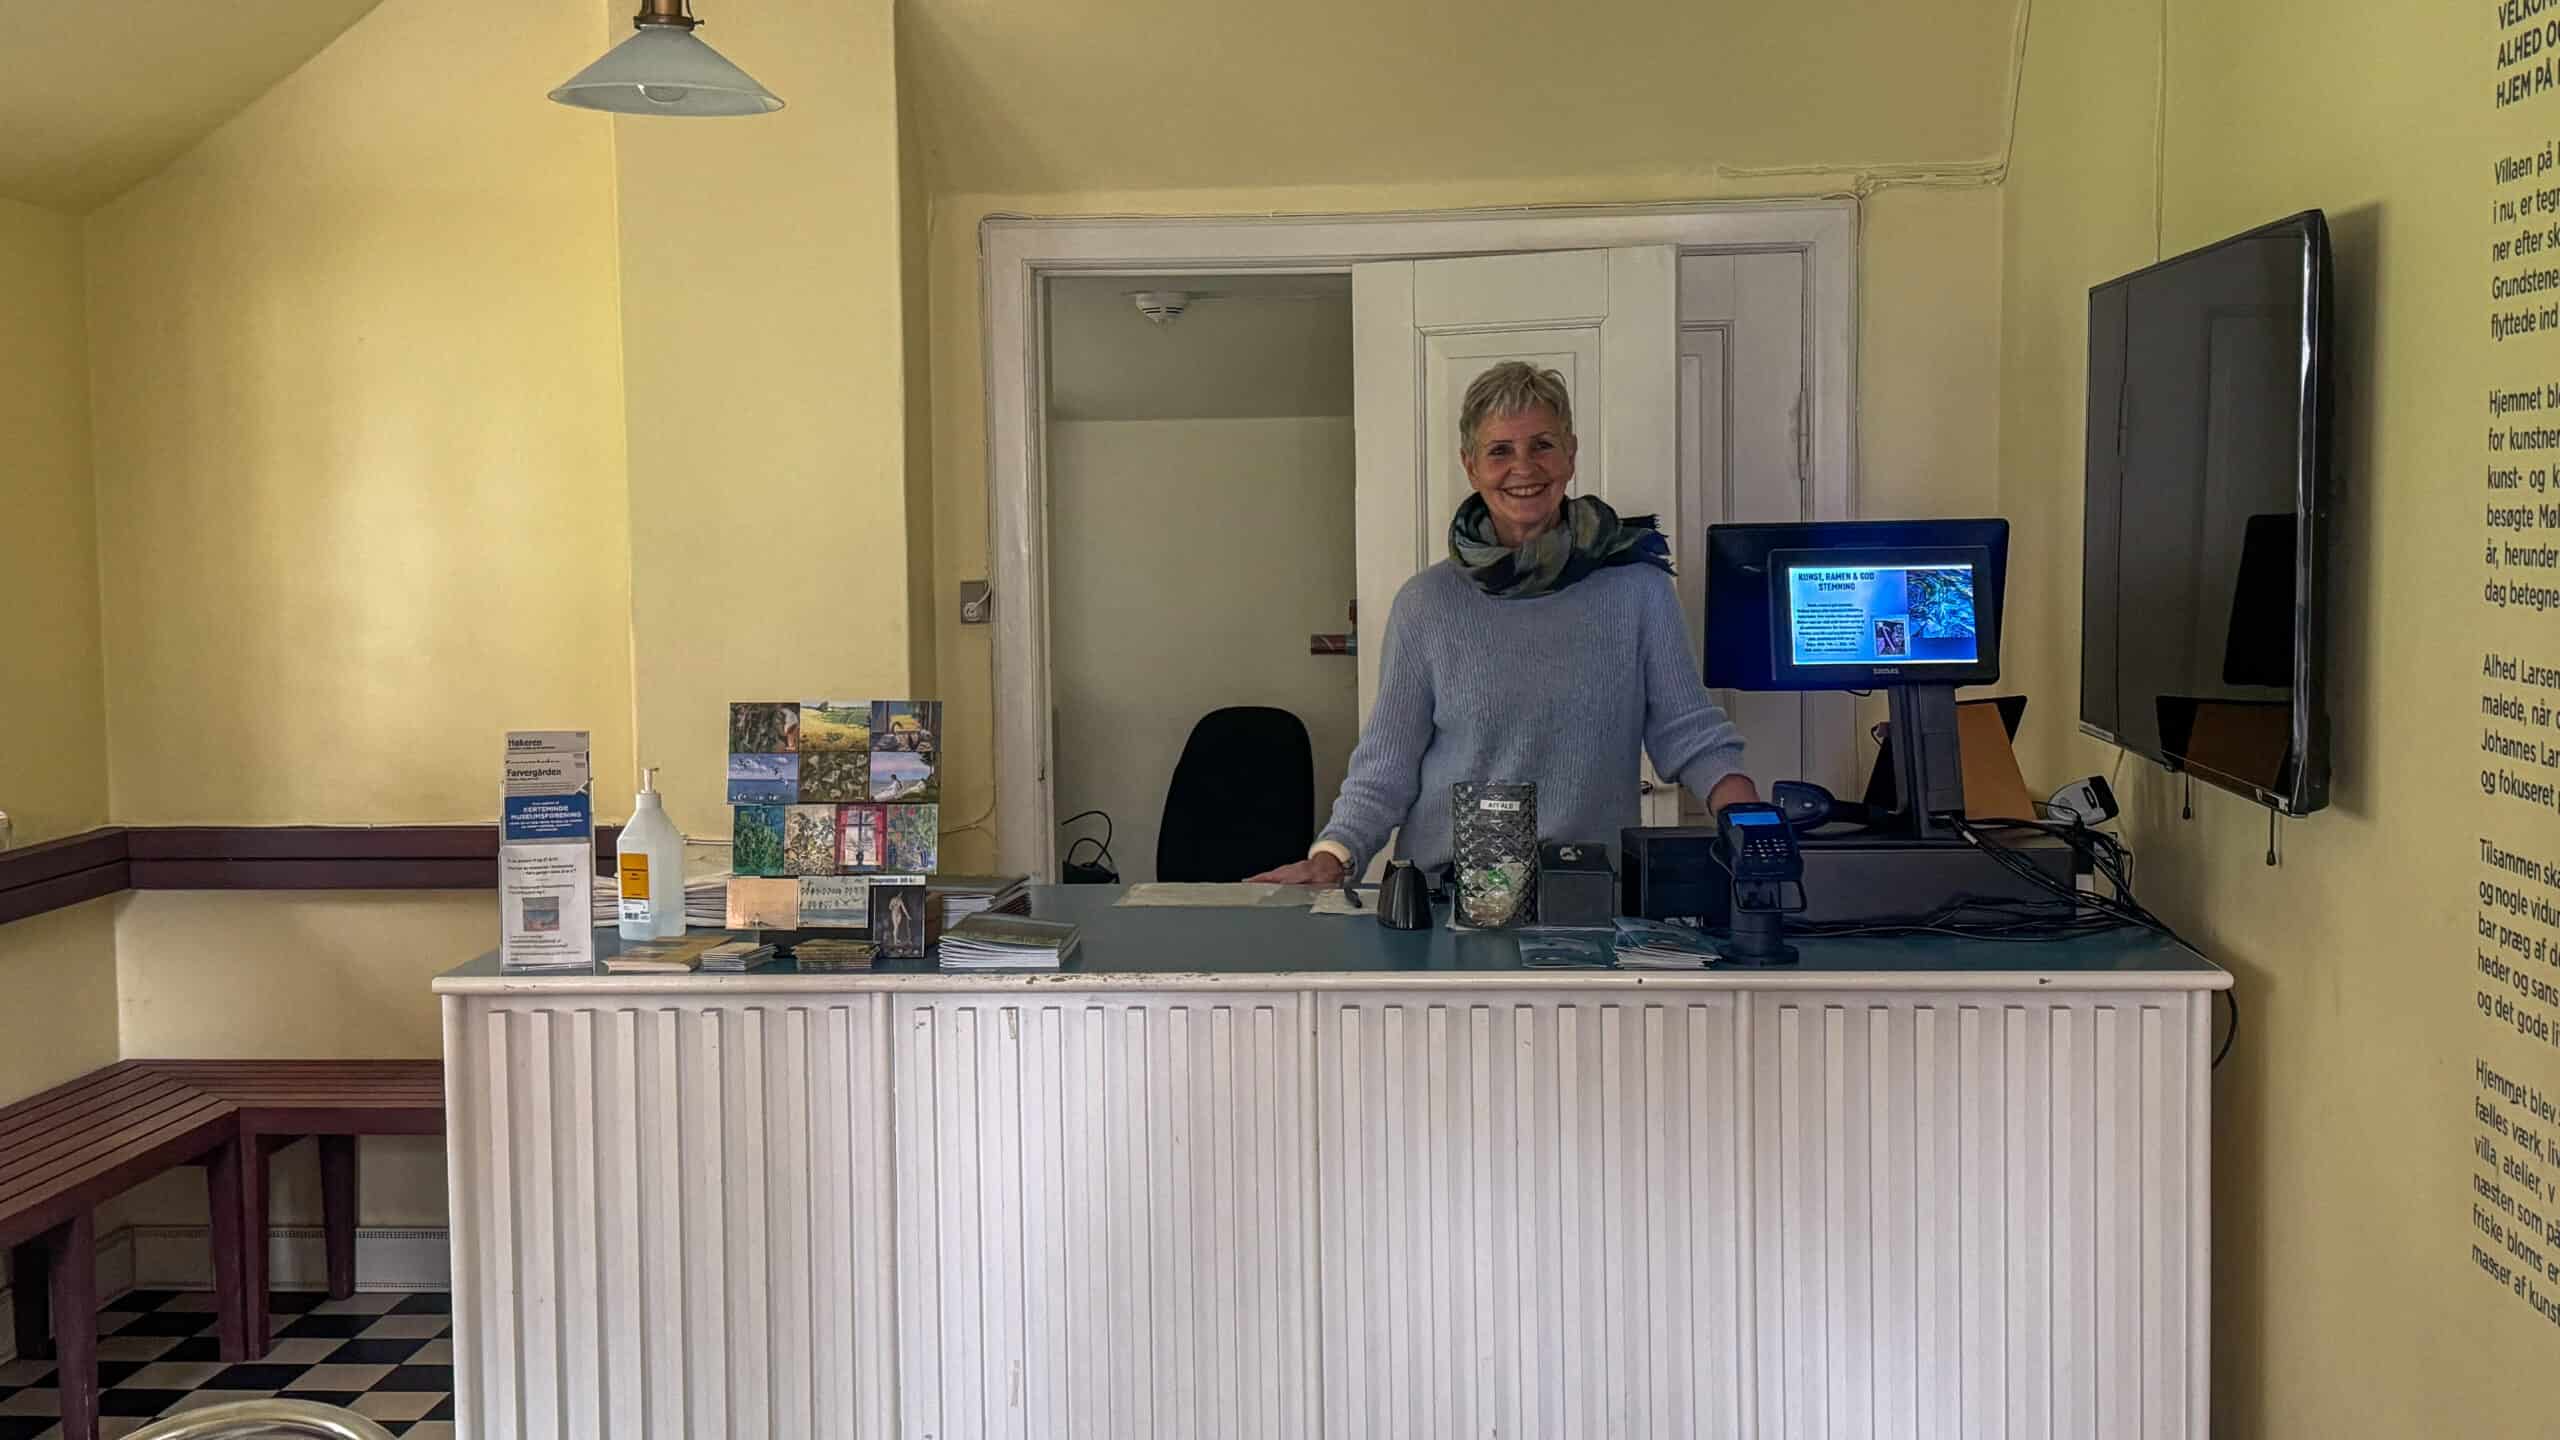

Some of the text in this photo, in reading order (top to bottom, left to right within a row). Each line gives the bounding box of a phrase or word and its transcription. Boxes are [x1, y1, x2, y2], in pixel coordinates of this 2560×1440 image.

[2497, 20, 2560, 70] ALHED O
[2496, 70, 2531, 109] HJEM
[2535, 57, 2553, 94] PÅ
[2494, 156, 2532, 185] Villaen
[2537, 140, 2553, 177] på
[2500, 201, 2517, 223] nu,
[2520, 193, 2533, 216] er
[2492, 239, 2512, 263] ner
[2515, 229, 2544, 257] efter
[2491, 302, 2559, 342] flyttede ind
[2489, 384, 2542, 418] Hjemmet
[2488, 427, 2504, 451] for
[2488, 464, 2523, 490] kunst-
[2529, 469, 2545, 493] og
[2487, 504, 2534, 532] besøgte
[2485, 538, 2559, 569] år, herunder
[2485, 576, 2506, 608] dag
[2482, 653, 2517, 681] Alhed
[2481, 692, 2528, 727] malede,
[2531, 698, 2552, 728] når
[2481, 727, 2537, 763] Johannes
[2481, 769, 2496, 795] og
[2499, 768, 2554, 807] fokuseret
[2479, 838, 2541, 883] Tilsammen
[2479, 880, 2494, 906] og
[2495, 886, 2527, 915] nogle
[2478, 910, 2496, 938] bar
[2499, 925, 2531, 960] præg
[2534, 938, 2546, 962] af
[2477, 947, 2559, 1008] heder og sans
[2477, 990, 2491, 1016] og
[2495, 995, 2514, 1025] det
[2517, 1013, 2549, 1042] gode
[2476, 1056, 2556, 1124] Hjemmet blev
[2475, 1096, 2508, 1136] fælles
[2512, 1122, 2544, 1162] værk,
[2503, 1155, 2542, 1200] atelier,
[2474, 1173, 2514, 1217] næsten
[2518, 1203, 2542, 1236] som
[2473, 1203, 2503, 1244] friske
[2507, 1225, 2543, 1273] bloms
[2472, 1244, 2512, 1285] masser
[2514, 1275, 2527, 1300] af
